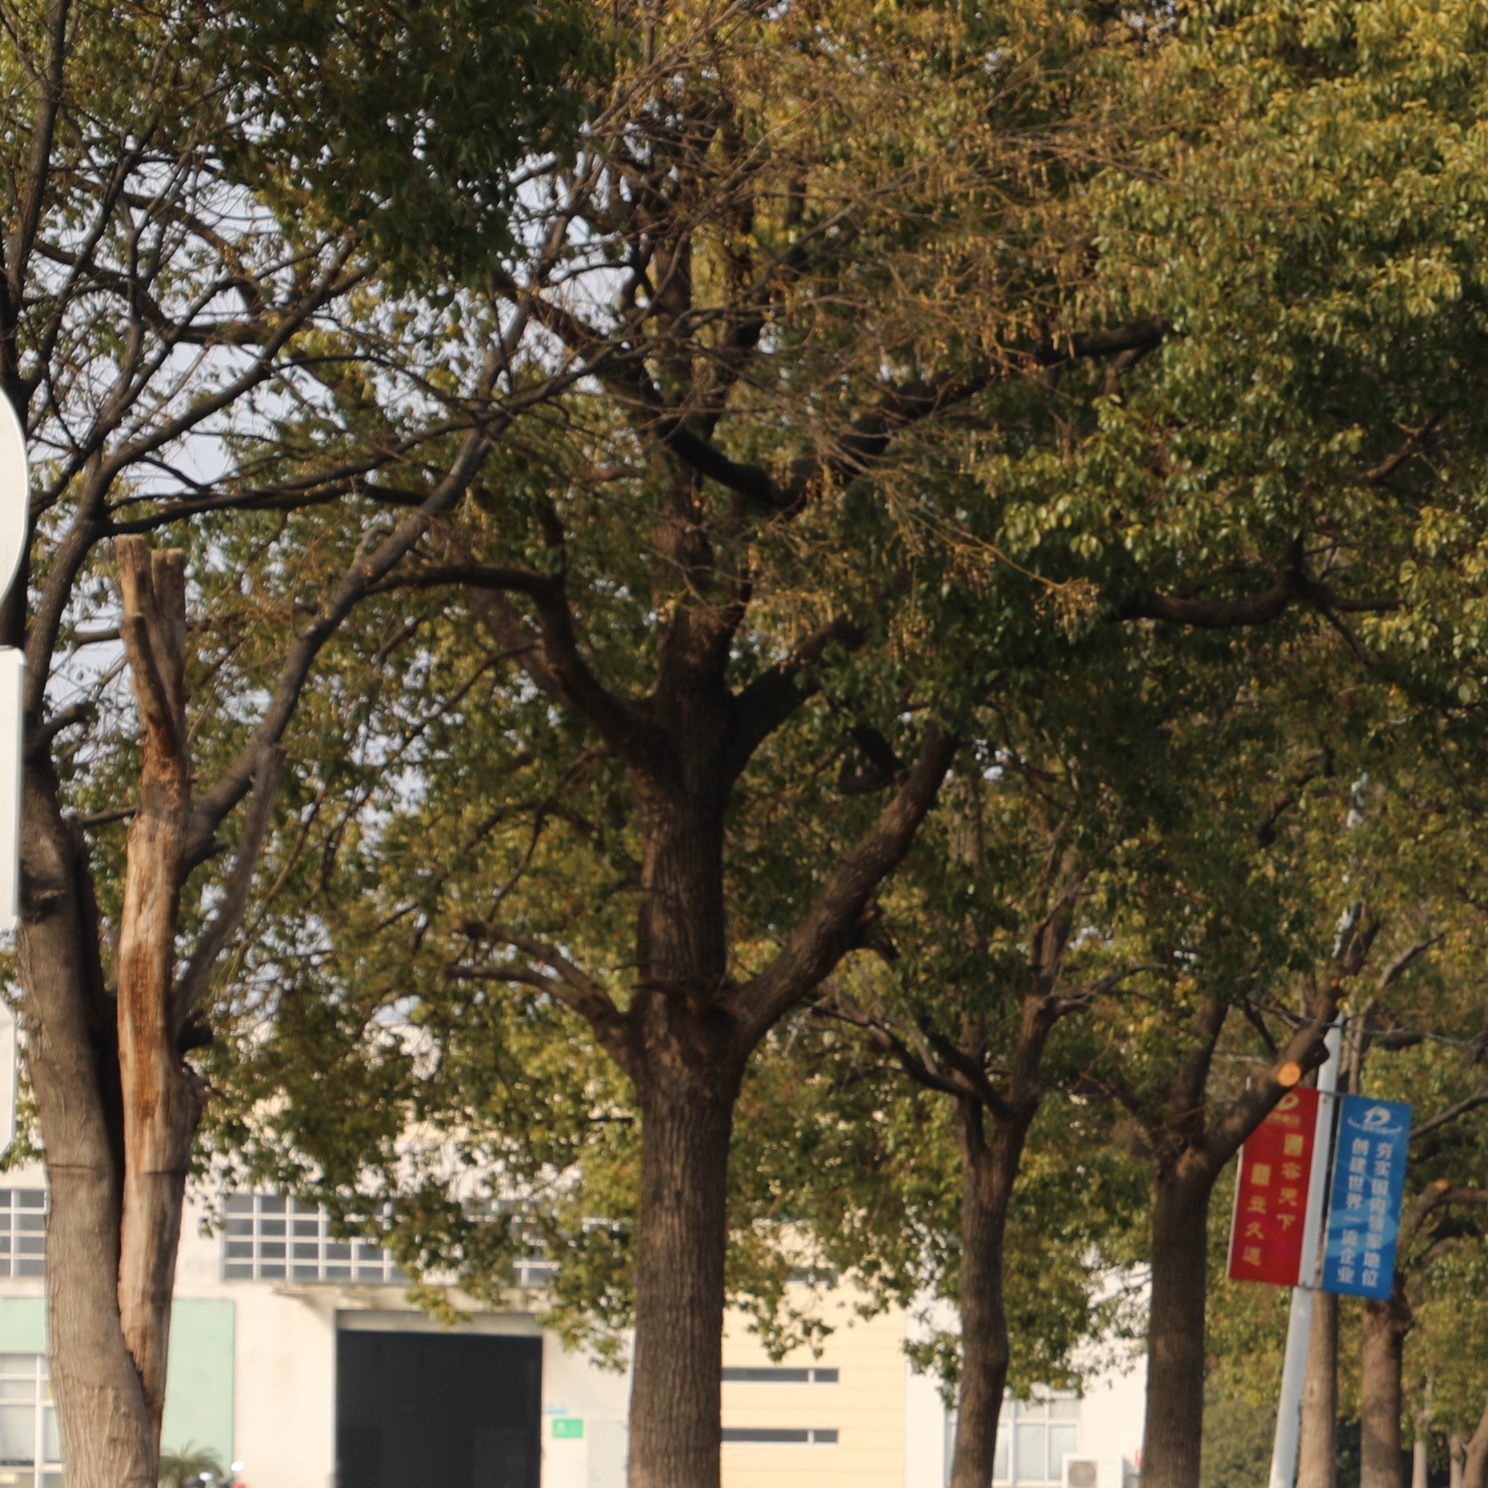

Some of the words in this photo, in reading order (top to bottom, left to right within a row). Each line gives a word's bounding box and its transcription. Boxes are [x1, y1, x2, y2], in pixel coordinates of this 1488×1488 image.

[1337, 1137, 1369, 1284] 创建世界一流企业
[1361, 1141, 1393, 1288] 夯实国内领军地位
